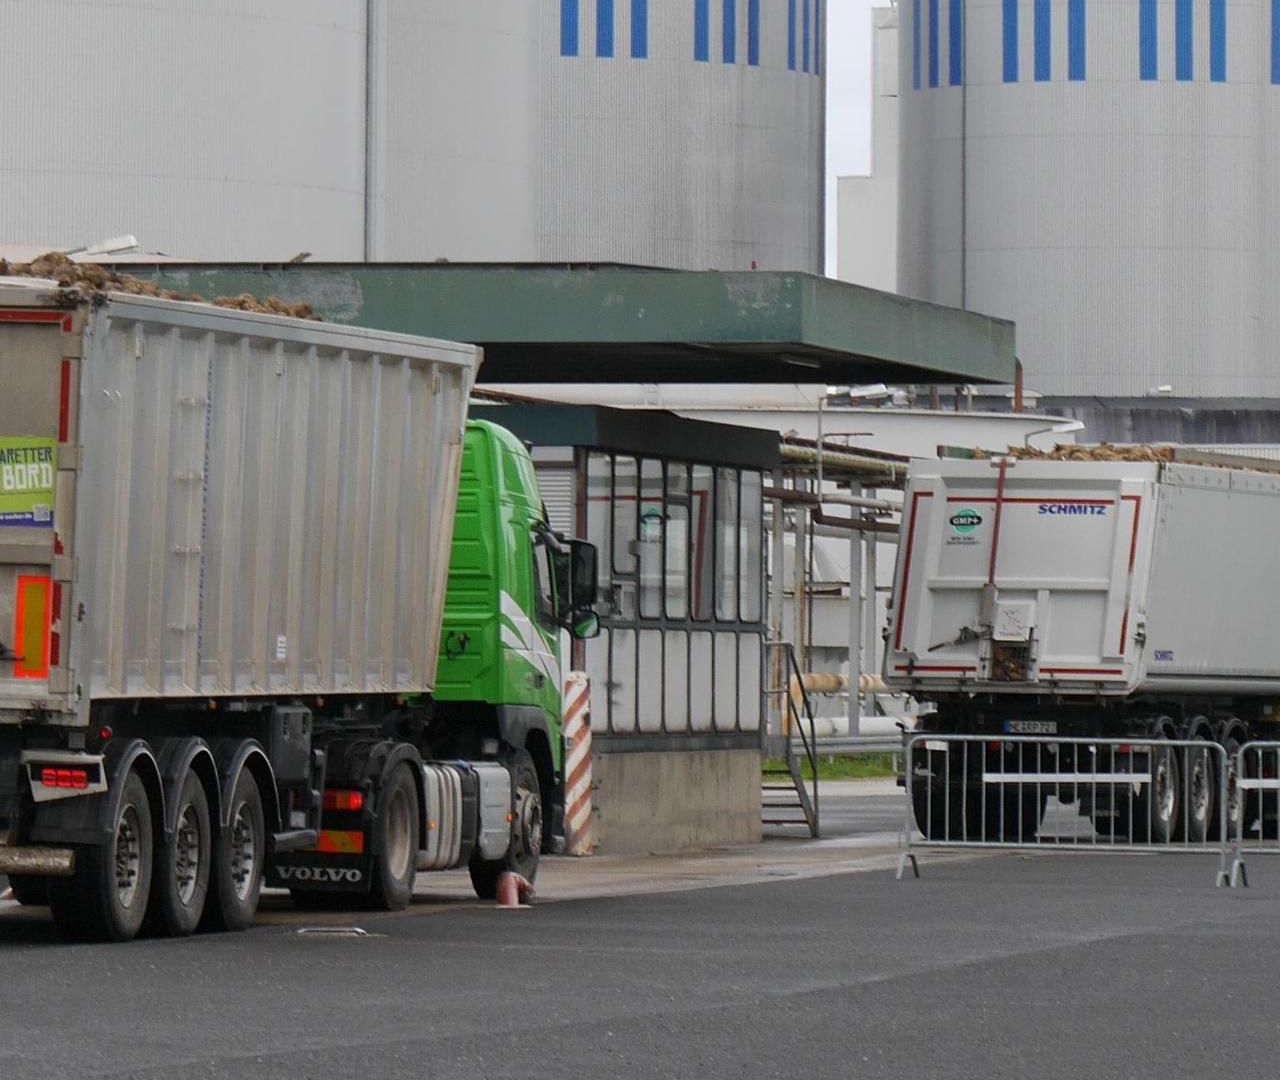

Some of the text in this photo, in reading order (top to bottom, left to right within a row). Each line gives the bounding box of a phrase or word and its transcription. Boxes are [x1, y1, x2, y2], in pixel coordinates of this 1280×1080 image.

[3, 461, 53, 490] BORD
[1038, 504, 1107, 515] SCHMITZ
[274, 866, 362, 882] VOLVO
